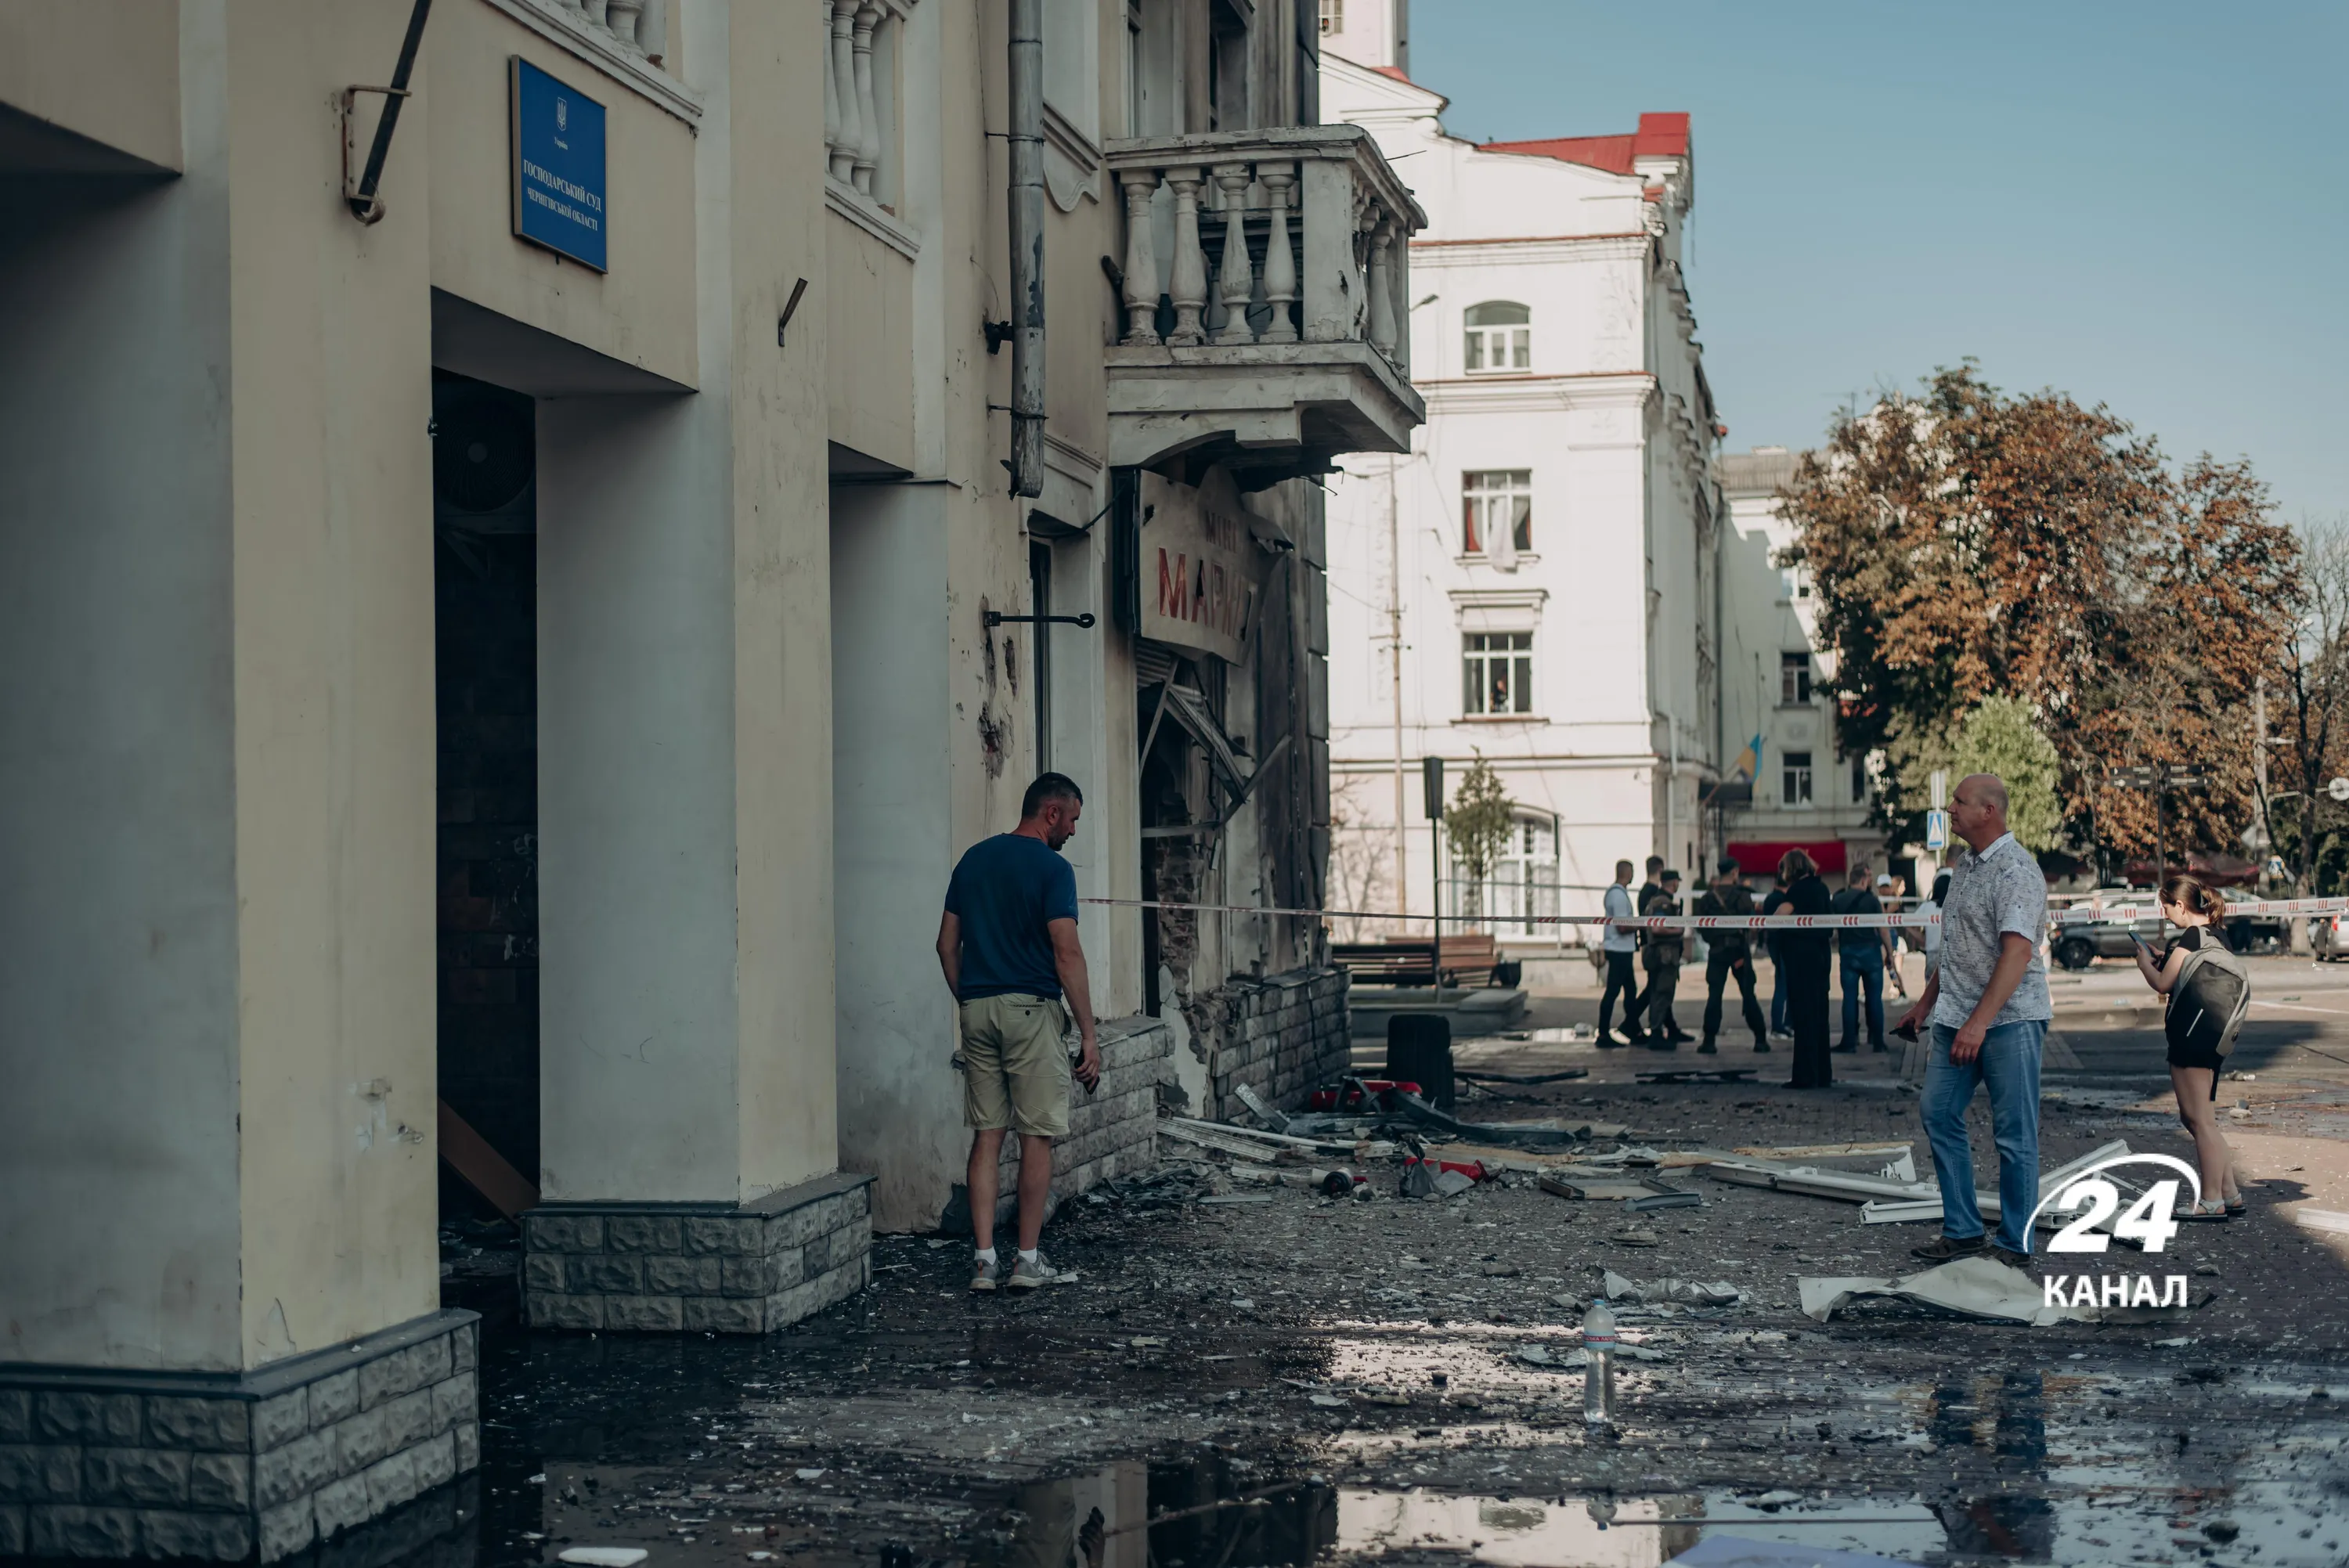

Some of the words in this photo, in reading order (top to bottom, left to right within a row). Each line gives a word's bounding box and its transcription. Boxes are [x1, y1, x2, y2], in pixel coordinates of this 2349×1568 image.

[524, 159, 586, 204] ГОСПОДАРСЬКИЙ
[586, 192, 601, 213] СУД
[527, 186, 572, 219] ЧЕРНІГІВСЬКОЇ
[572, 209, 598, 232] ОБЛАСТІ
